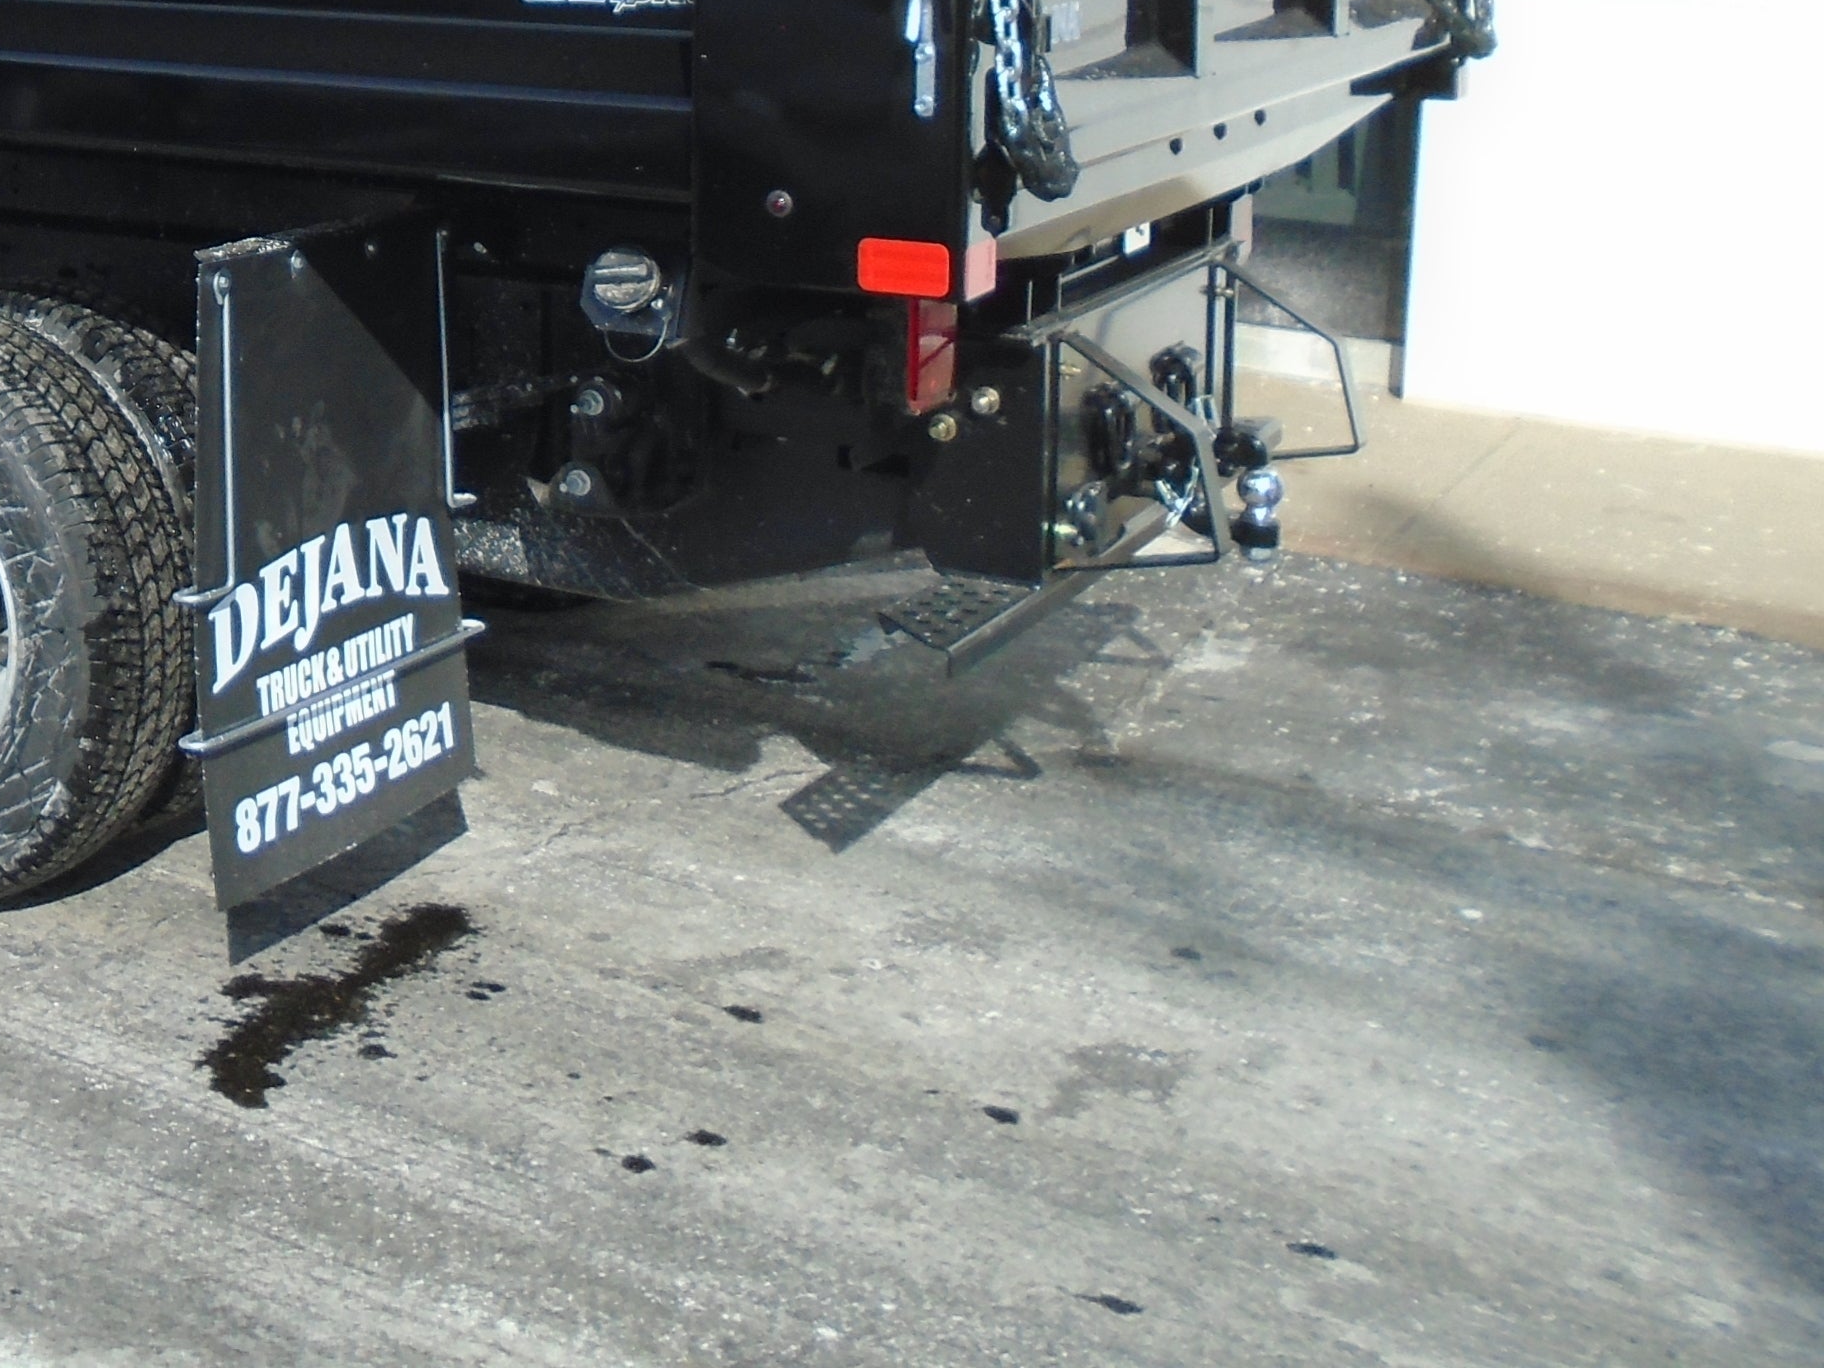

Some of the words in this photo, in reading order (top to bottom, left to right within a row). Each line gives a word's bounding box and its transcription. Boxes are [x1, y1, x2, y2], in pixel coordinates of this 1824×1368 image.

[210, 514, 449, 693] DEJANA
[235, 702, 454, 853] 877-335-2621
[287, 669, 396, 755] EQUIPMENT
